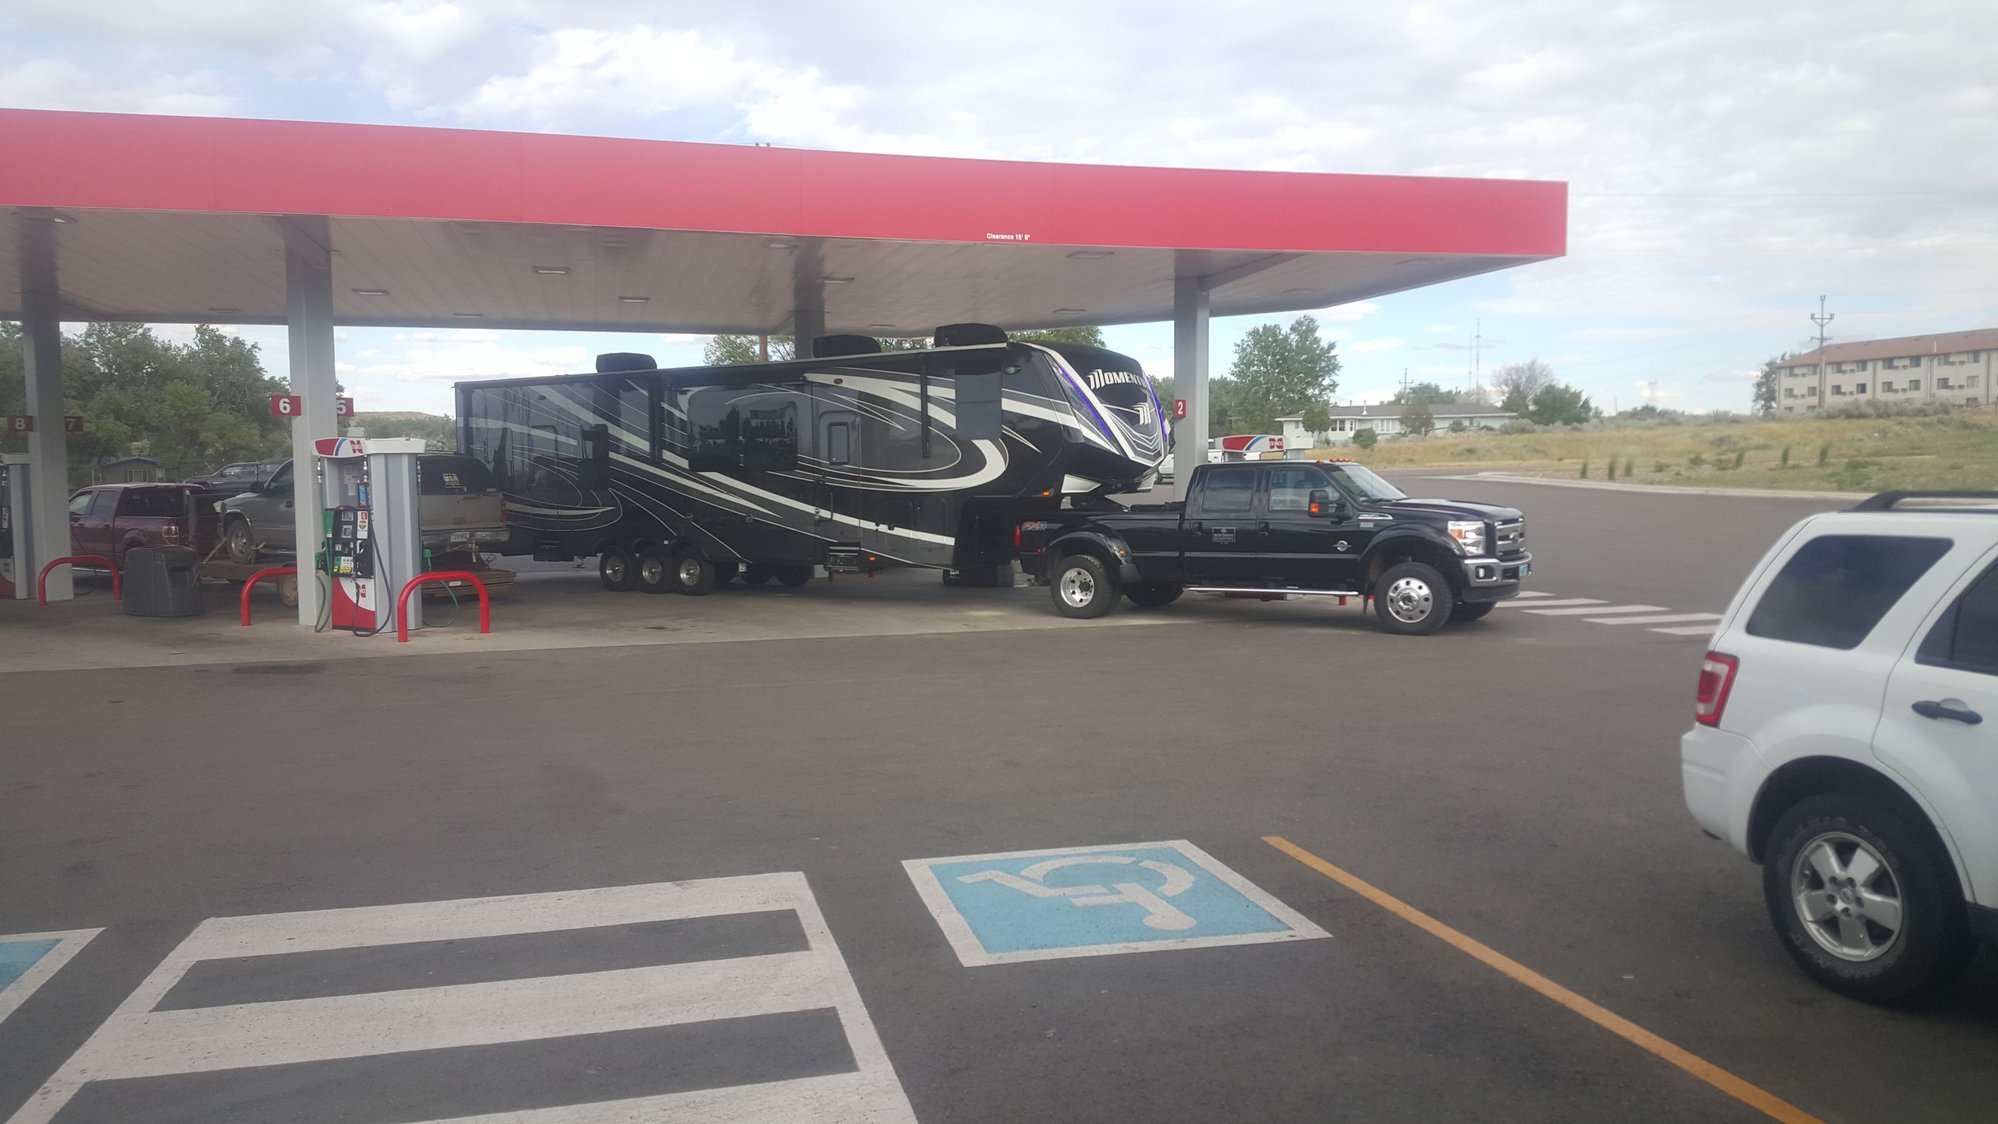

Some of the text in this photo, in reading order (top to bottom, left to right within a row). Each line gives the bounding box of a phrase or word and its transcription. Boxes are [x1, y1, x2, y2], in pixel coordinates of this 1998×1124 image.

[279, 398, 291, 414] 6
[336, 400, 347, 414] 5
[1177, 401, 1184, 415] 2
[15, 417, 26, 430] 8
[66, 418, 76, 430] 7
